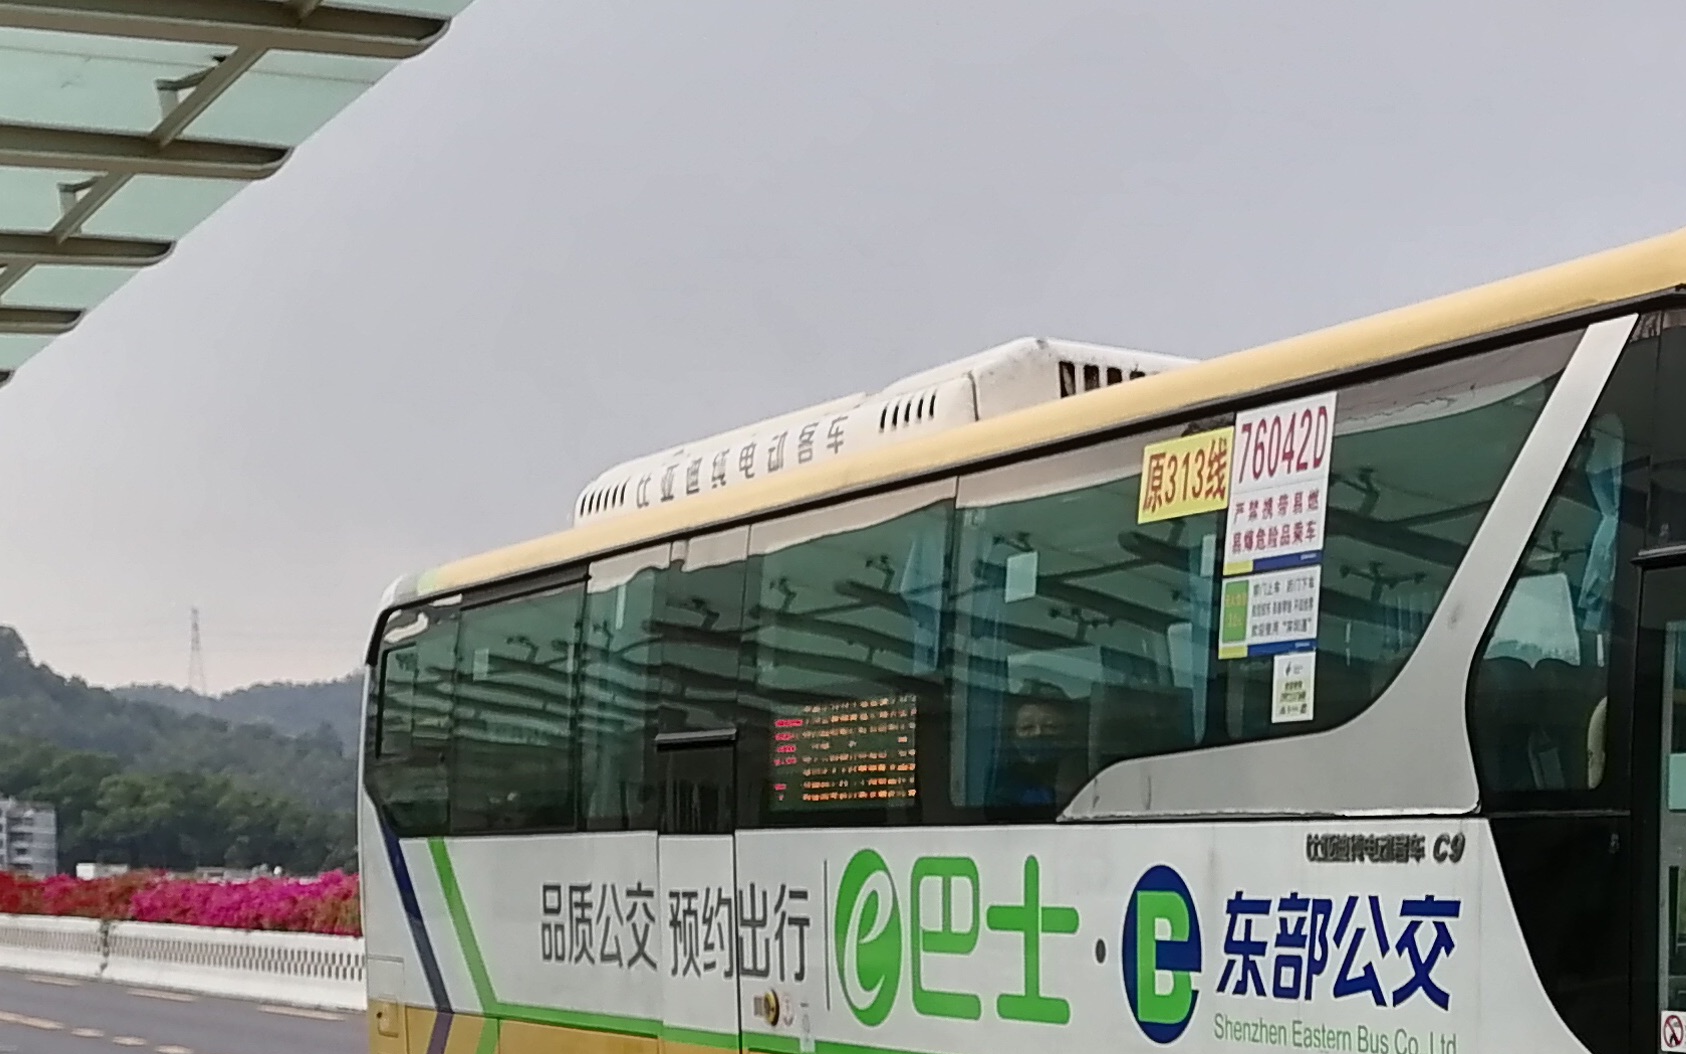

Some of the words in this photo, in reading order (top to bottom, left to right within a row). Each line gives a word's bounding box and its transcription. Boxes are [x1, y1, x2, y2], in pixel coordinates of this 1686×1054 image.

[1141, 438, 1228, 514] 原313线
[1237, 405, 1329, 484] 76042D
[1432, 831, 1466, 864] C9
[541, 881, 658, 972] 品质公交
[668, 882, 812, 983] 预约出行
[1216, 890, 1461, 1012] 东部公交
[1213, 1012, 1288, 1046] Shenzhen
[1291, 1019, 1352, 1052] Eastern
